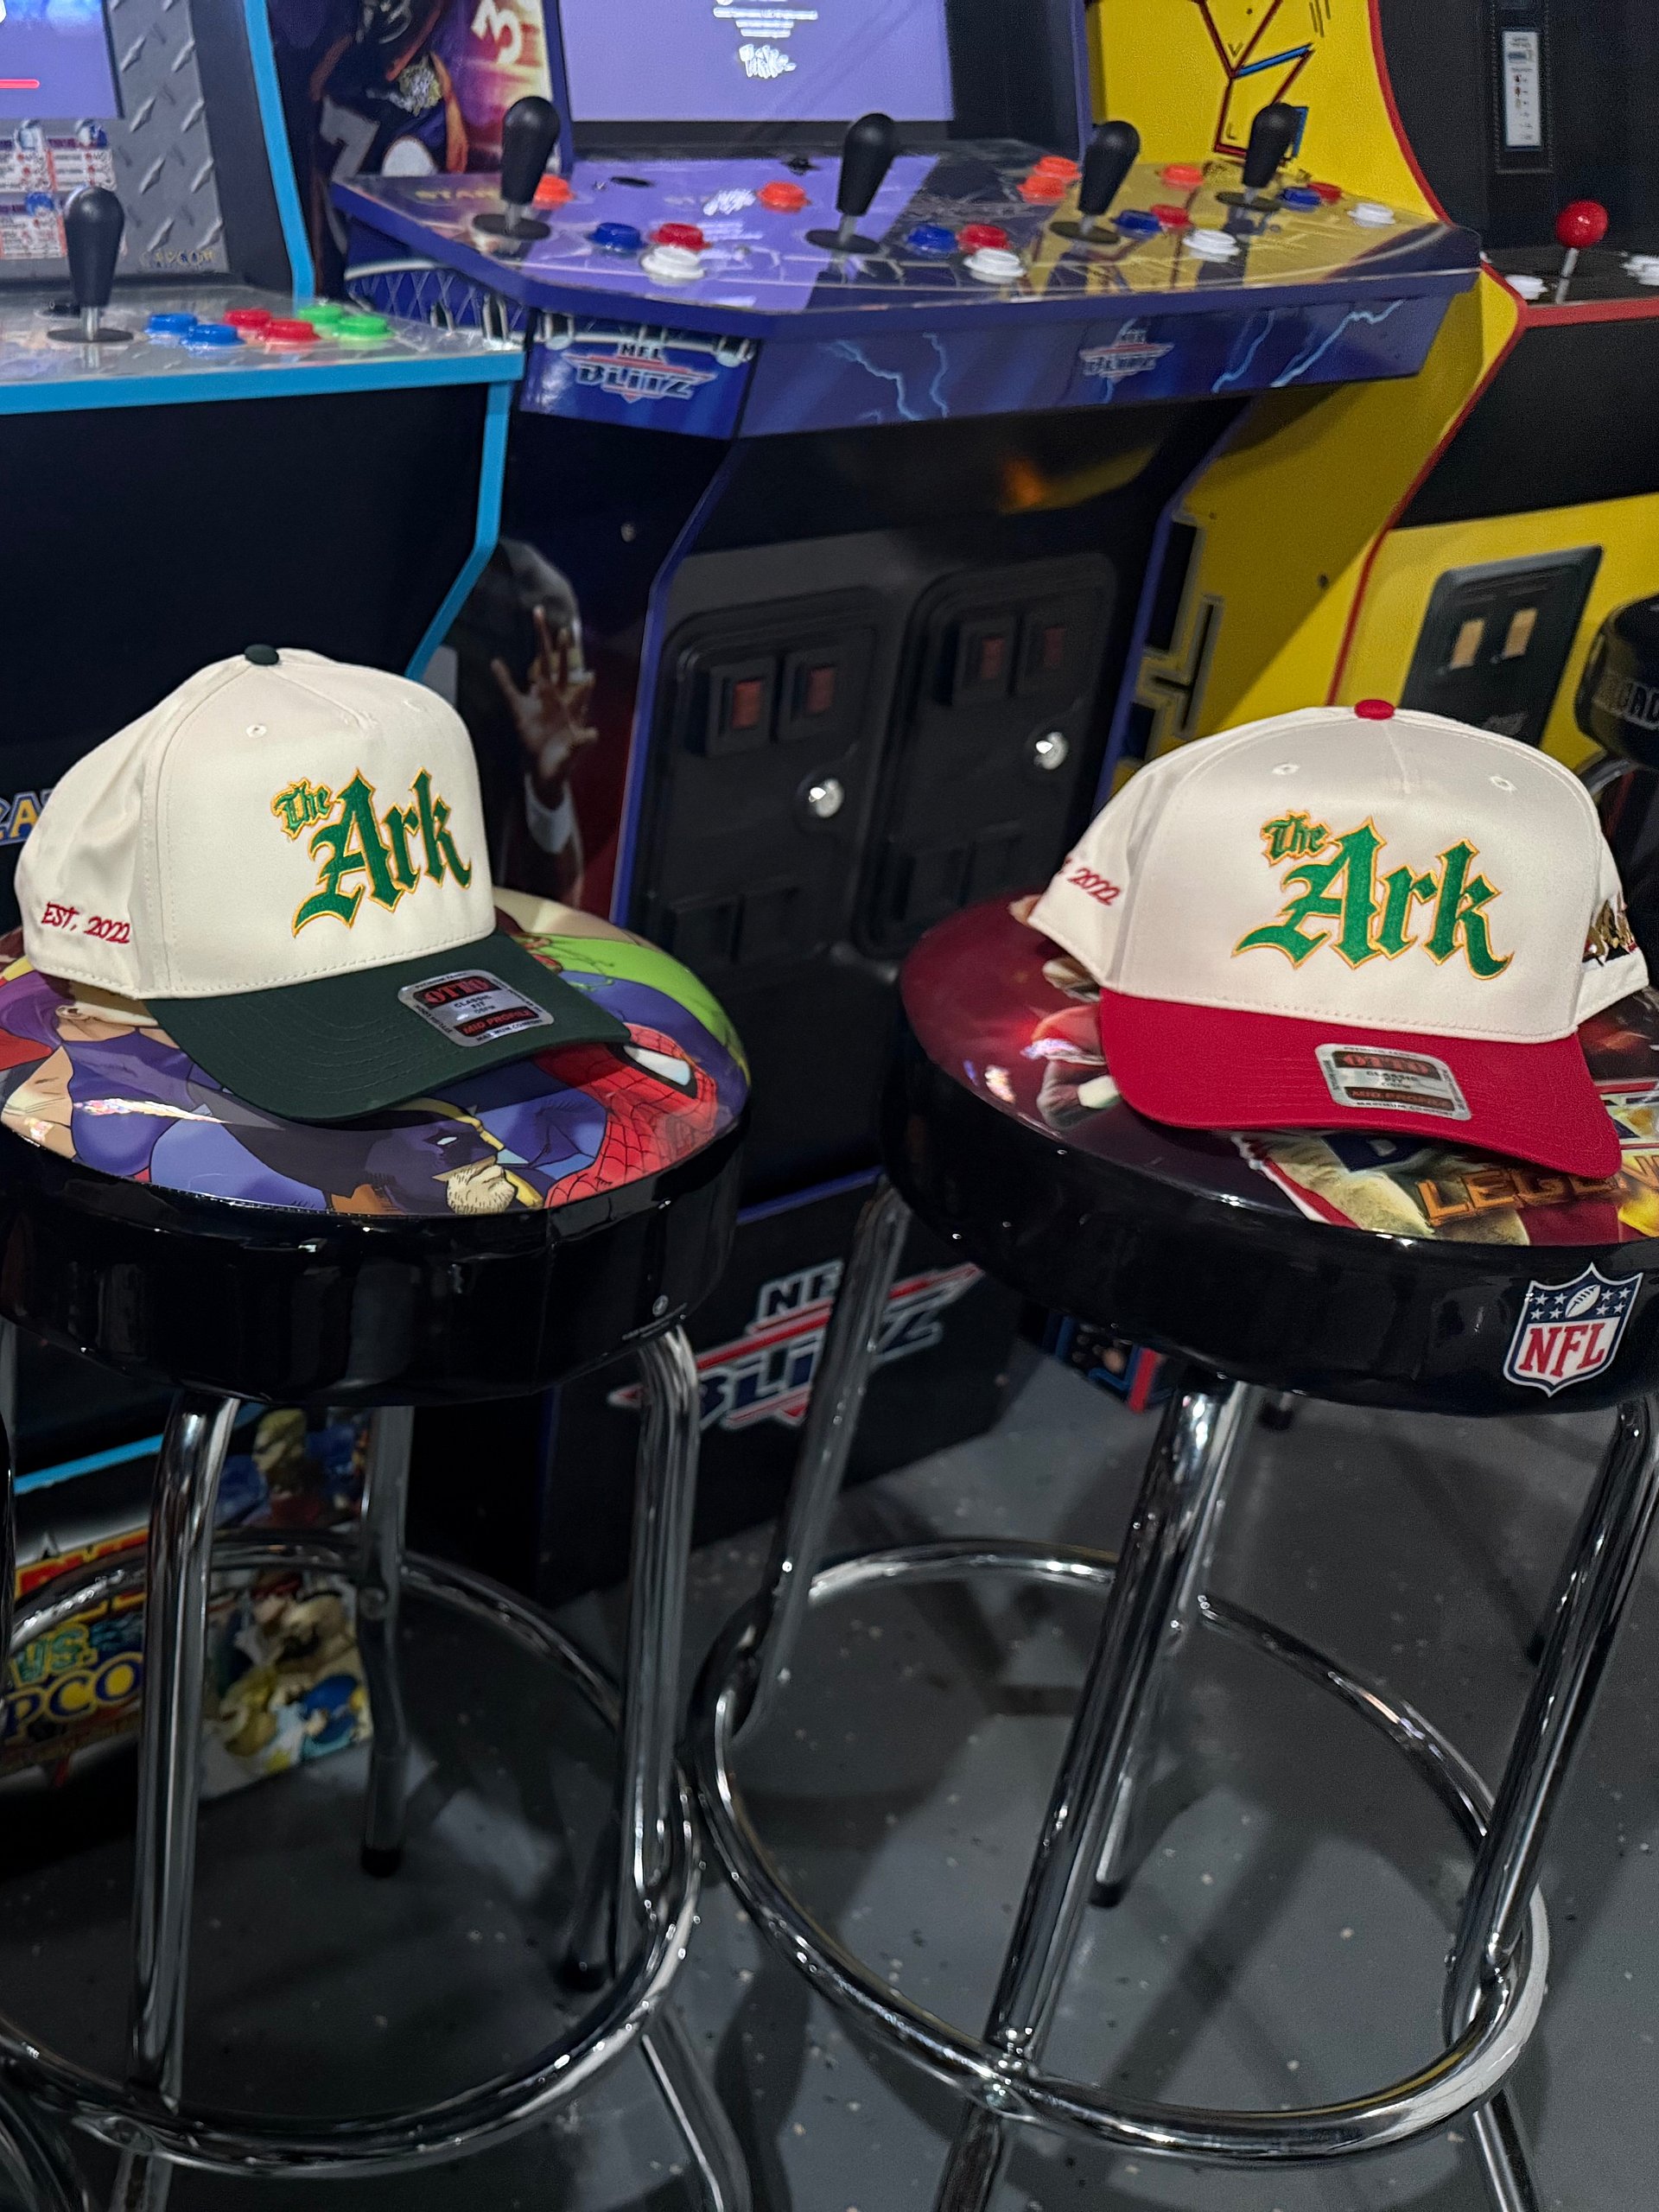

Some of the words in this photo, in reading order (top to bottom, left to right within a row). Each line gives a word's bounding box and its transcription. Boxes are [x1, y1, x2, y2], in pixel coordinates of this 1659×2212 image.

[291, 766, 473, 939] Ark
[1067, 867, 1122, 906] 2022
[1230, 816, 1515, 981] Ark
[83, 916, 130, 944] 2022
[463, 1021, 486, 1036] MID
[1518, 1322, 1605, 1378] NFL
